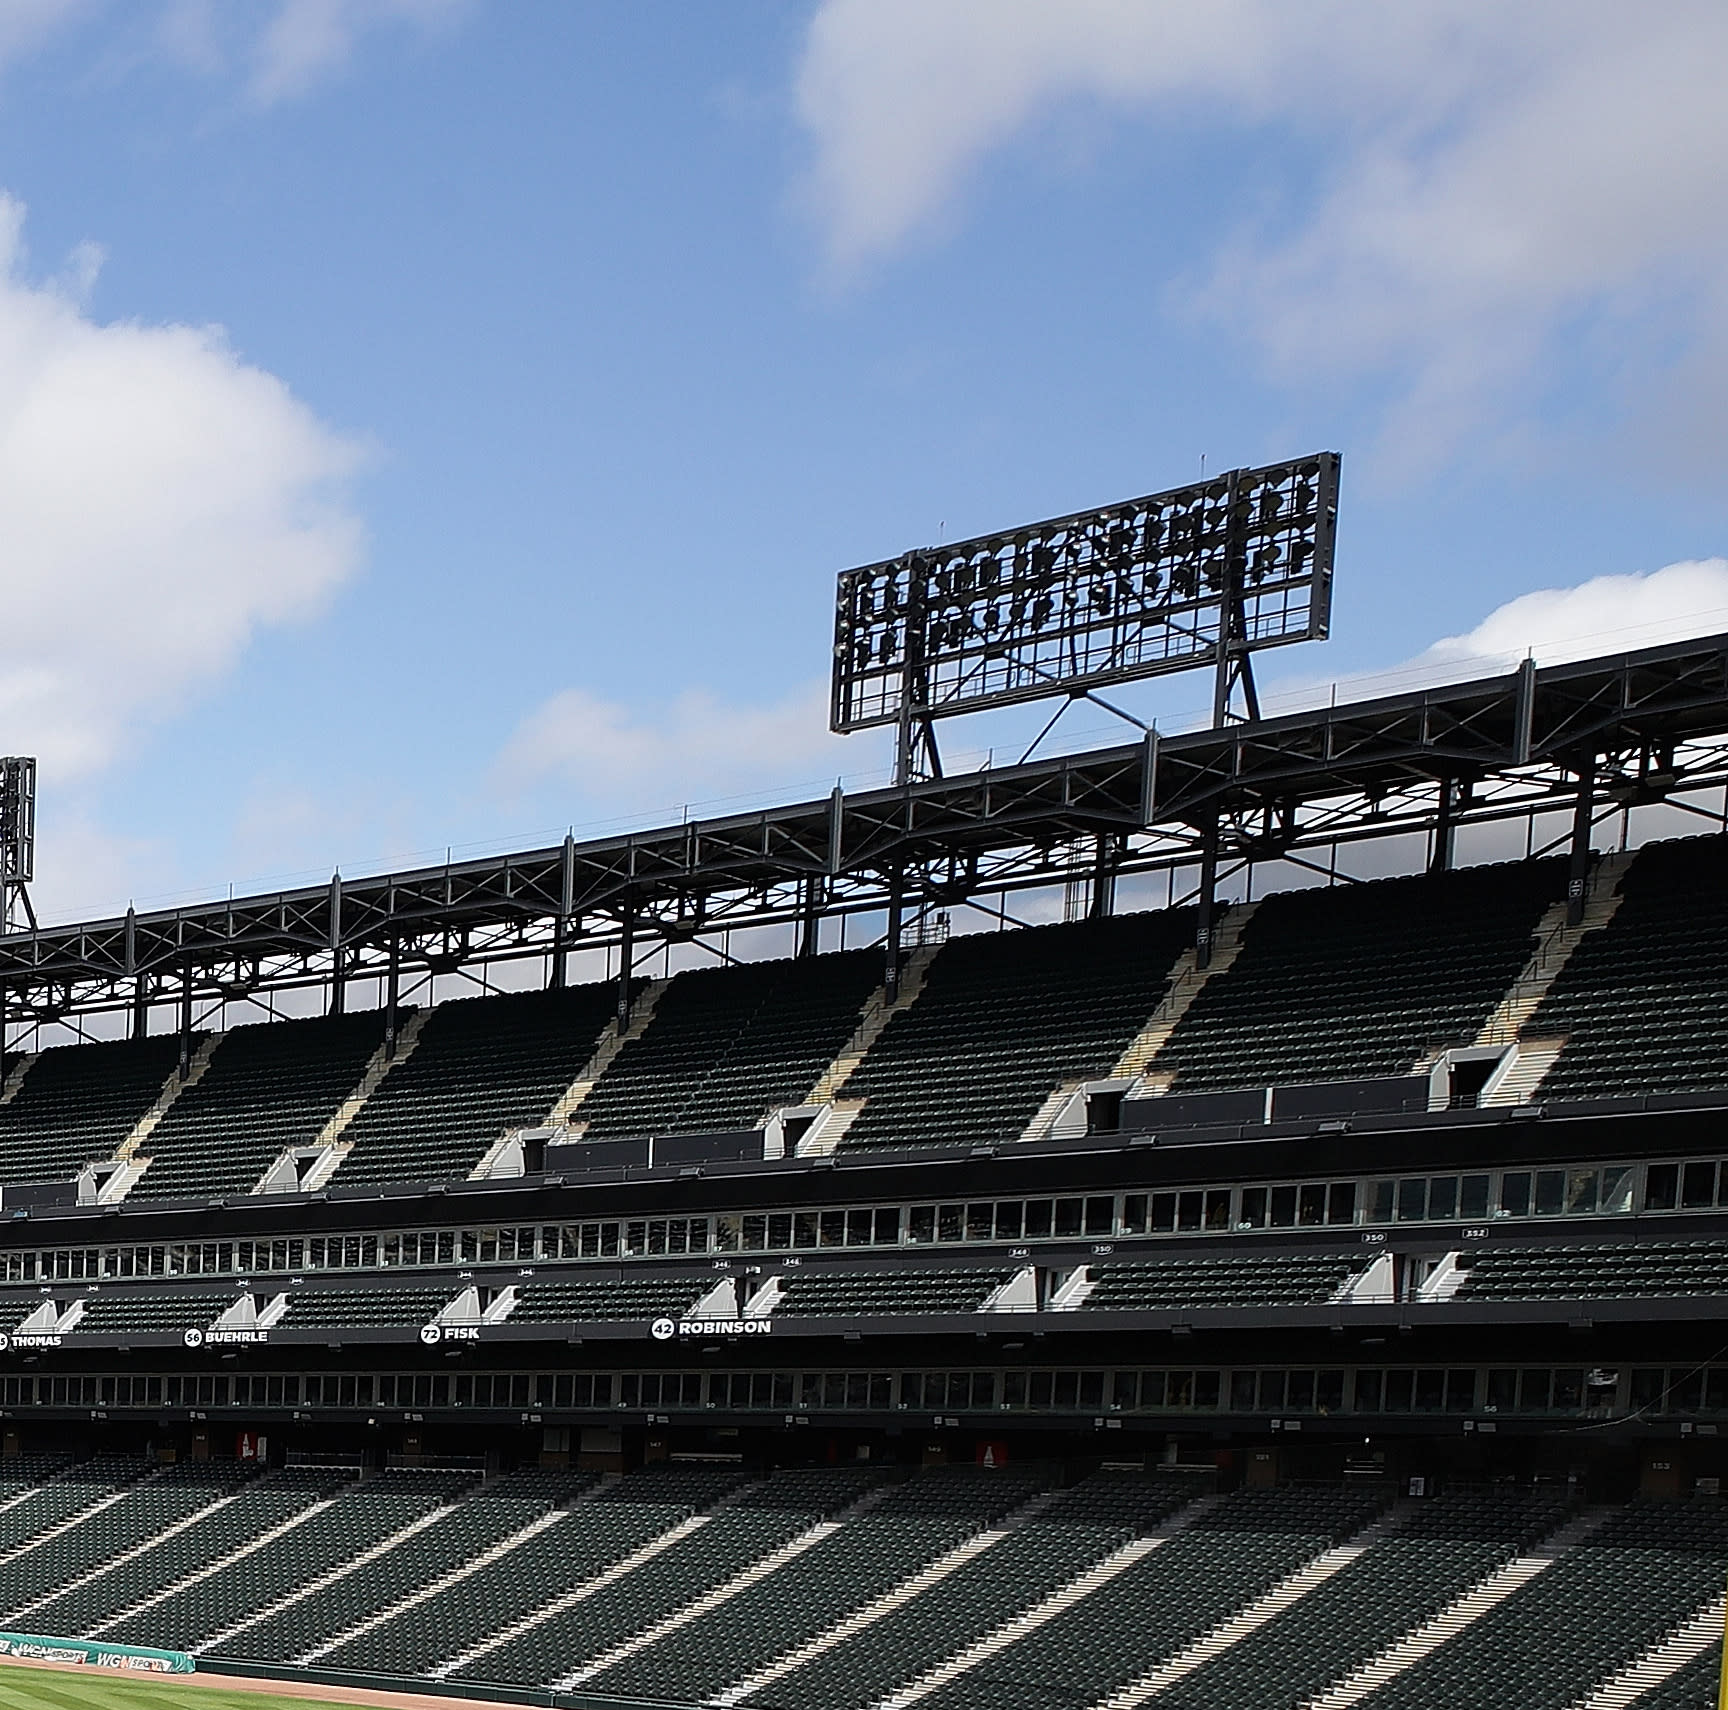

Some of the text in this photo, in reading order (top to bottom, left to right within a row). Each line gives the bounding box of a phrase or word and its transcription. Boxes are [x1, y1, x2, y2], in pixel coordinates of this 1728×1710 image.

[444, 1327, 480, 1340] FISK
[679, 1320, 772, 1335] ROBINSON
[11, 1336, 62, 1347] THOMAS
[205, 1331, 268, 1343] BUEHRLE
[97, 1652, 130, 1669] WGN
